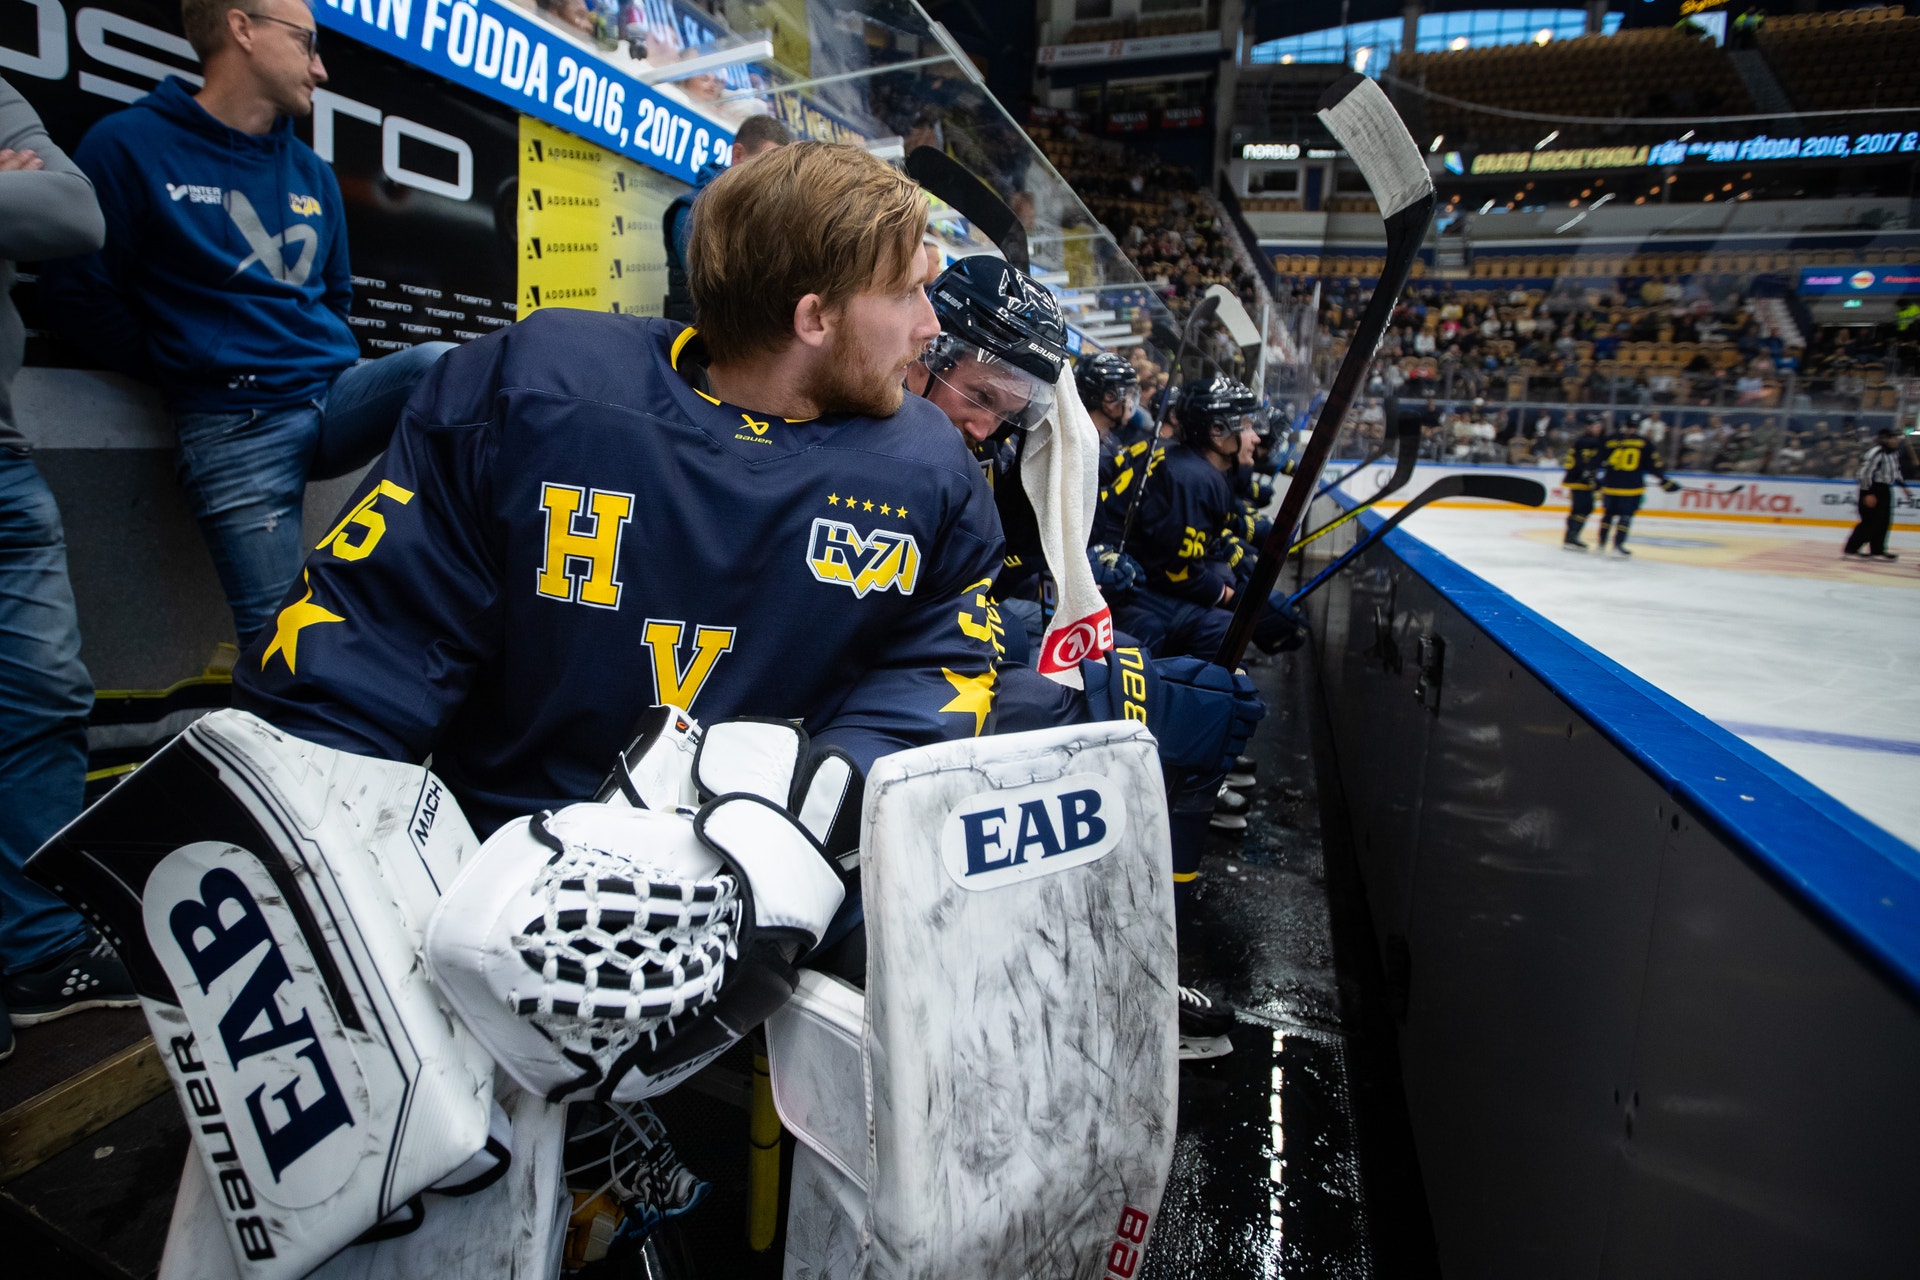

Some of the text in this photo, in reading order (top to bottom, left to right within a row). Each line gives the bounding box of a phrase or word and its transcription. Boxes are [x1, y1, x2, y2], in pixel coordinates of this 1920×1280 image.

[553, 56, 629, 148] 2016,
[634, 98, 693, 165] 2017
[1735, 134, 1802, 161] FÖDDA
[1800, 136, 1851, 158] 2016,
[1851, 132, 1902, 155] 2017
[1608, 447, 1642, 471] 40
[535, 481, 636, 611] H
[808, 520, 918, 591] HV71
[640, 618, 737, 713] V
[414, 779, 443, 847] MACH
[959, 787, 1107, 878] EAB
[169, 866, 356, 1185] EAB
[170, 1030, 277, 1263] BAUER
